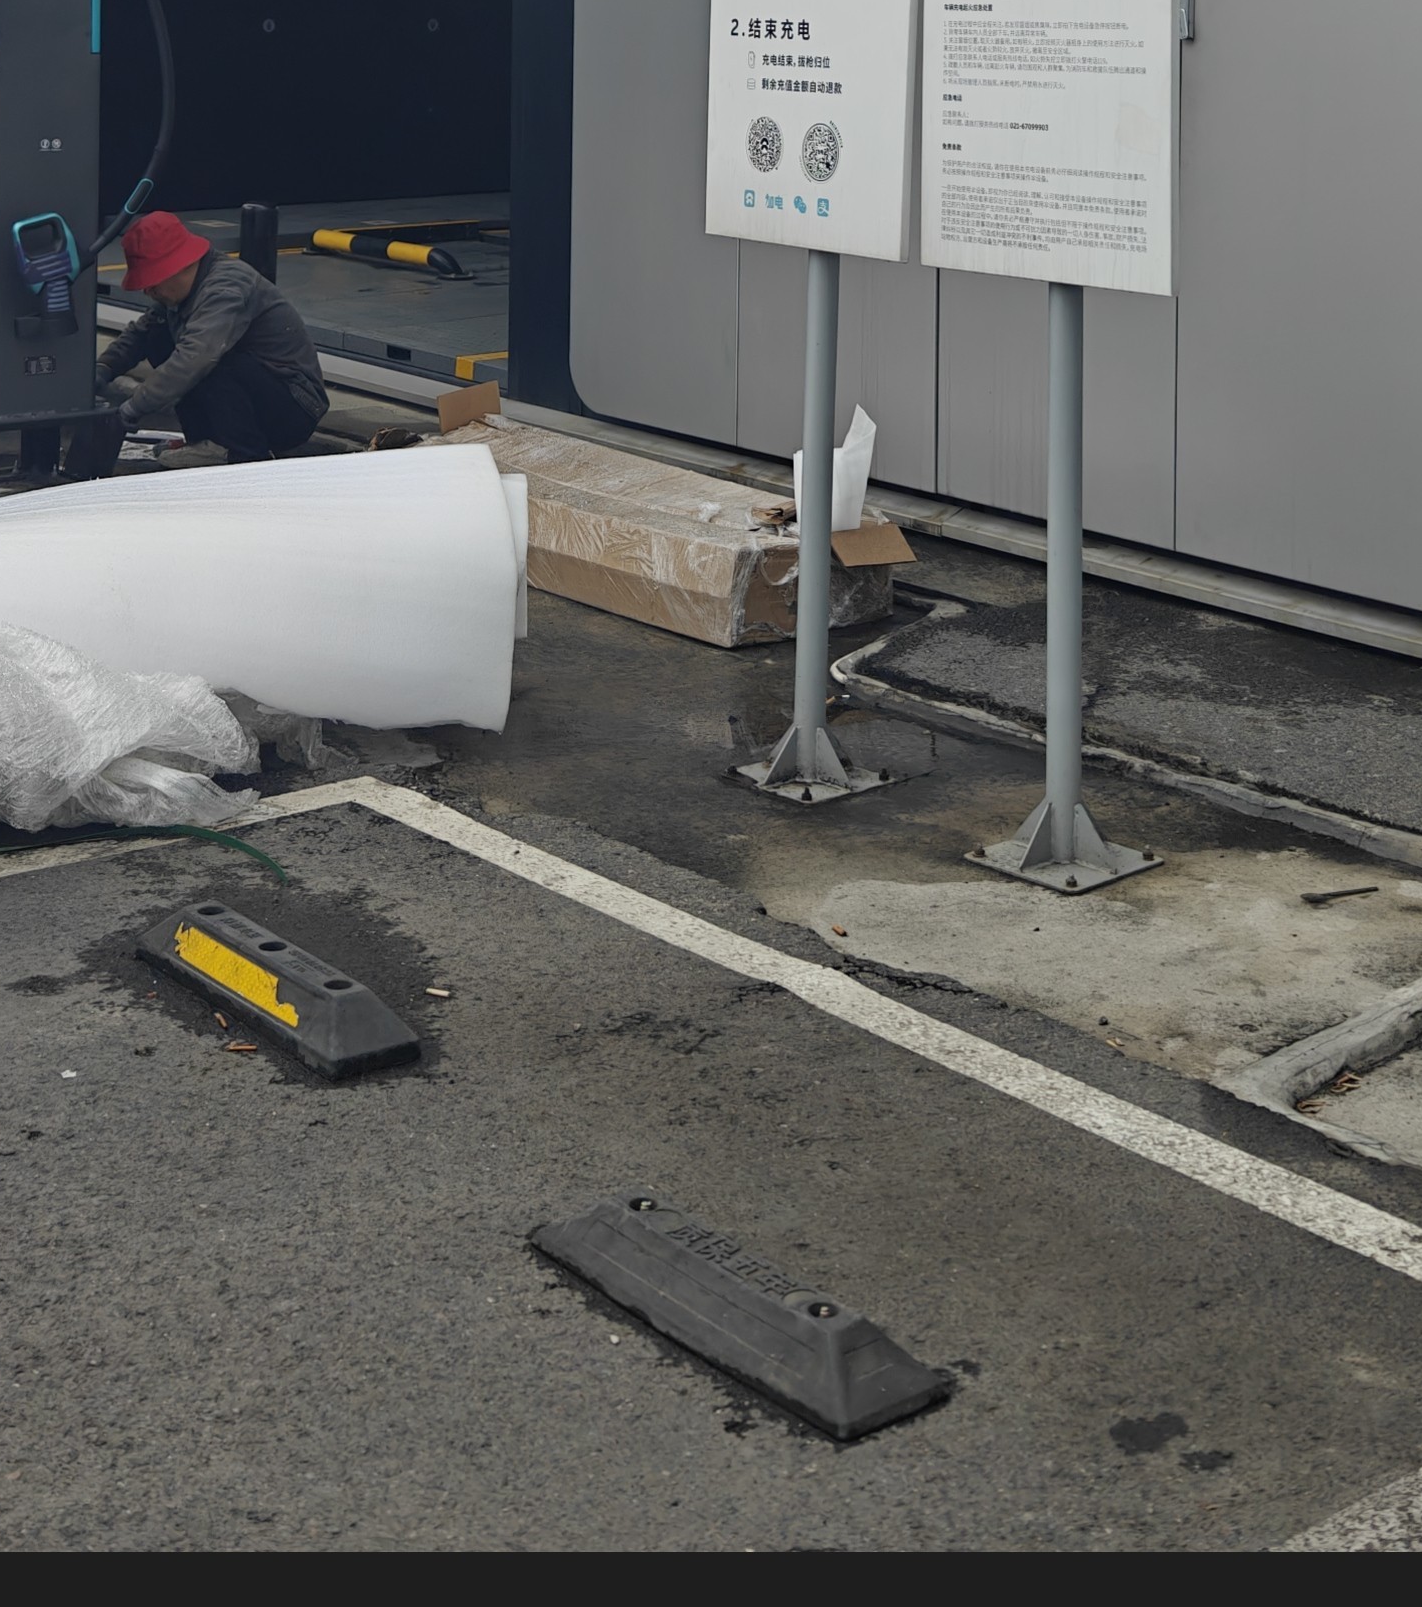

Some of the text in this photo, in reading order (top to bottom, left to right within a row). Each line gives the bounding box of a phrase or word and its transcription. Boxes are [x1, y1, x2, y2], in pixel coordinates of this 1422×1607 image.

[761, 77, 843, 94] 剩余充值金额自动退款
